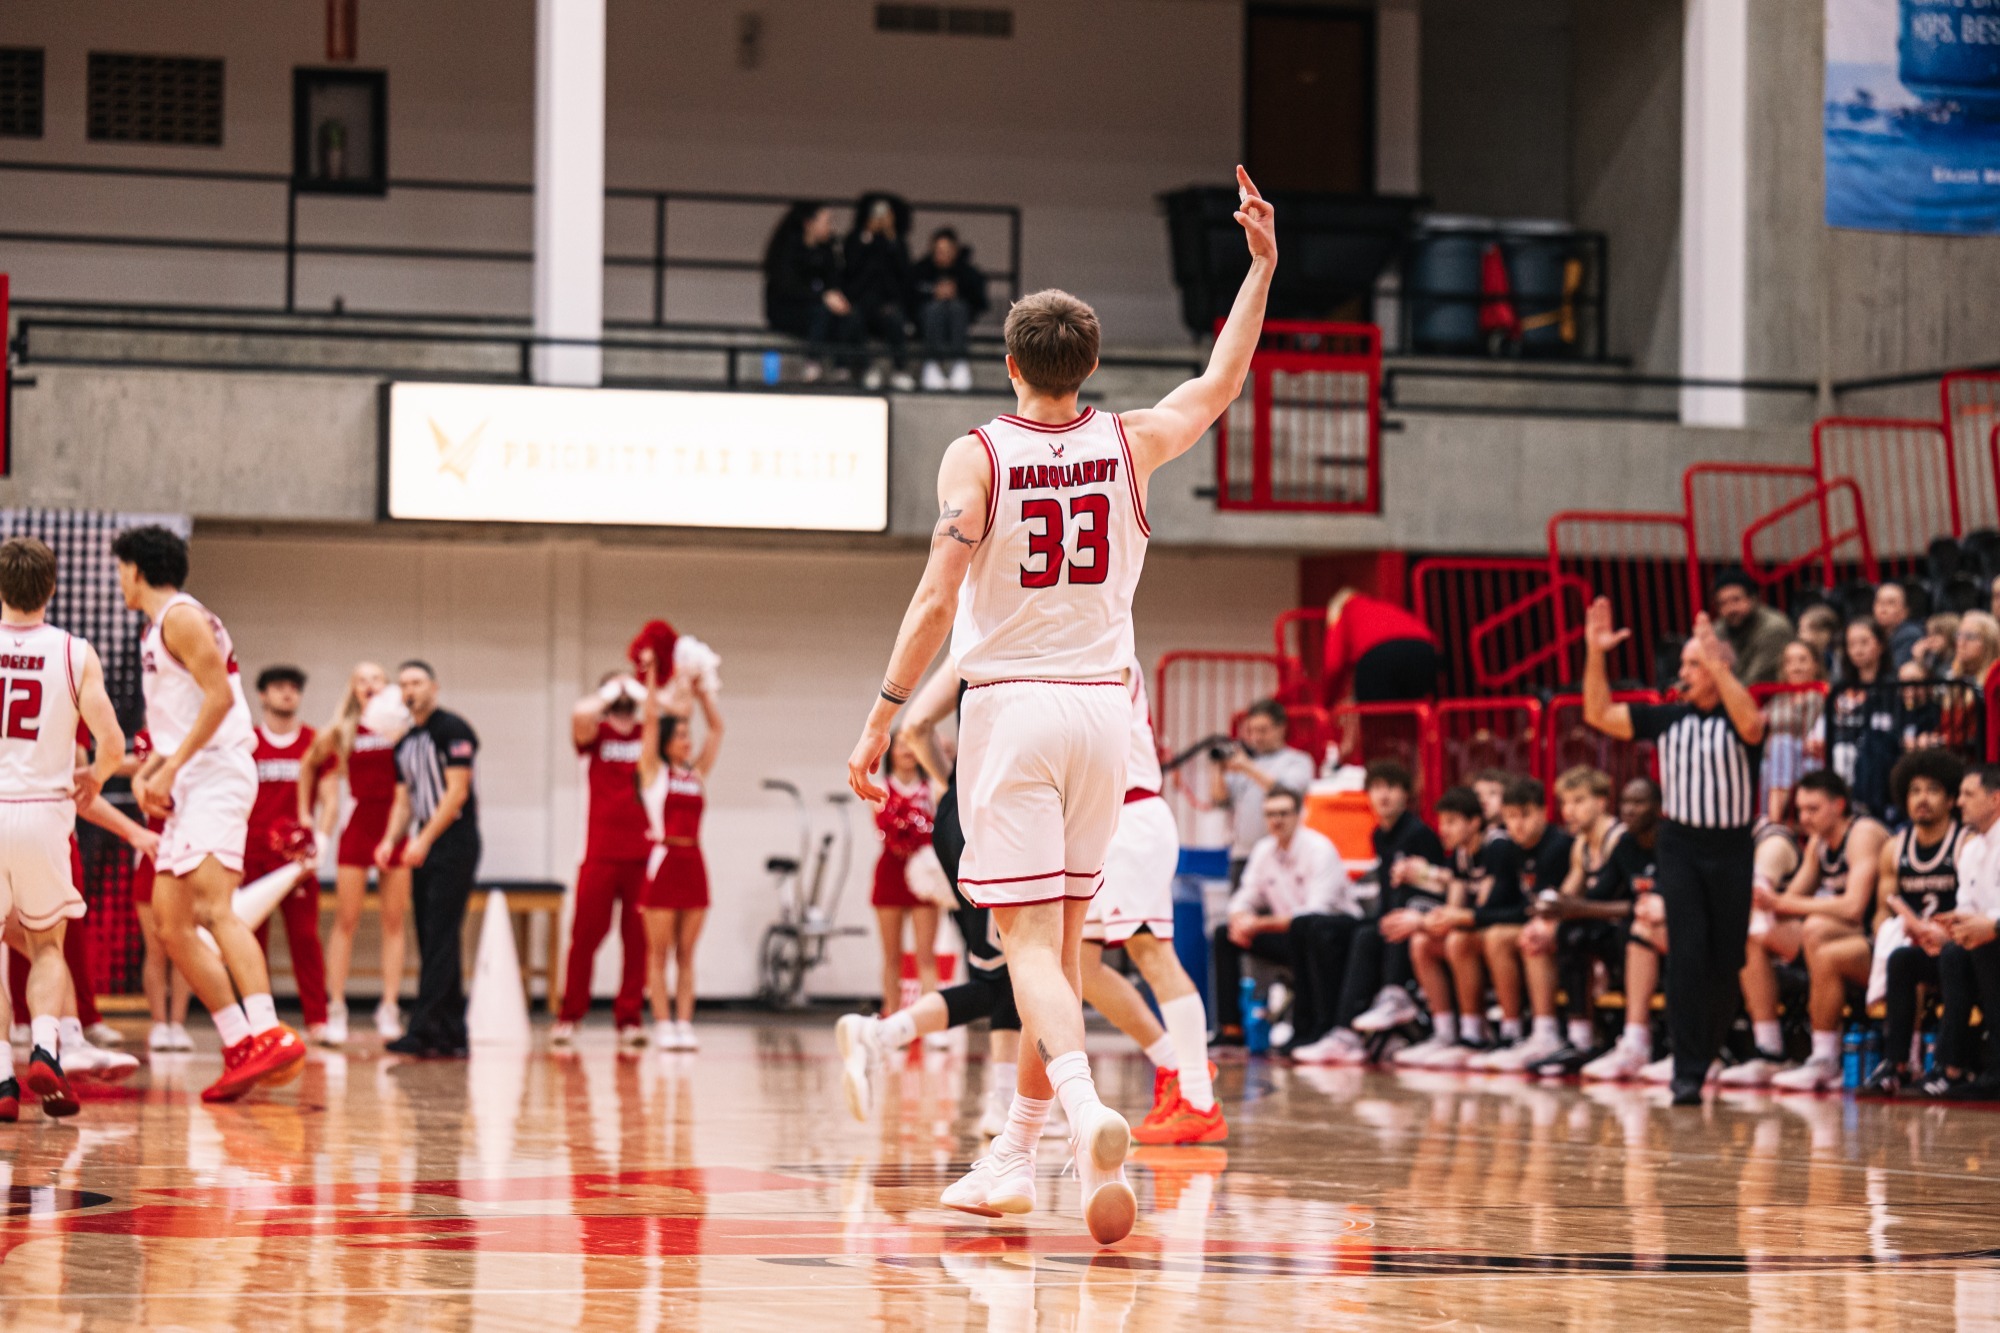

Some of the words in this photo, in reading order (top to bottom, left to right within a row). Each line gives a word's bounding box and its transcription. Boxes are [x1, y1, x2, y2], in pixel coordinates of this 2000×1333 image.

[502, 440, 659, 472] PRIORITY
[673, 446, 732, 476] TAX
[749, 450, 860, 479] RELIEF
[1008, 459, 1118, 490] MARQUARDT
[1020, 493, 1110, 588] 33
[0, 654, 45, 671] OGERS
